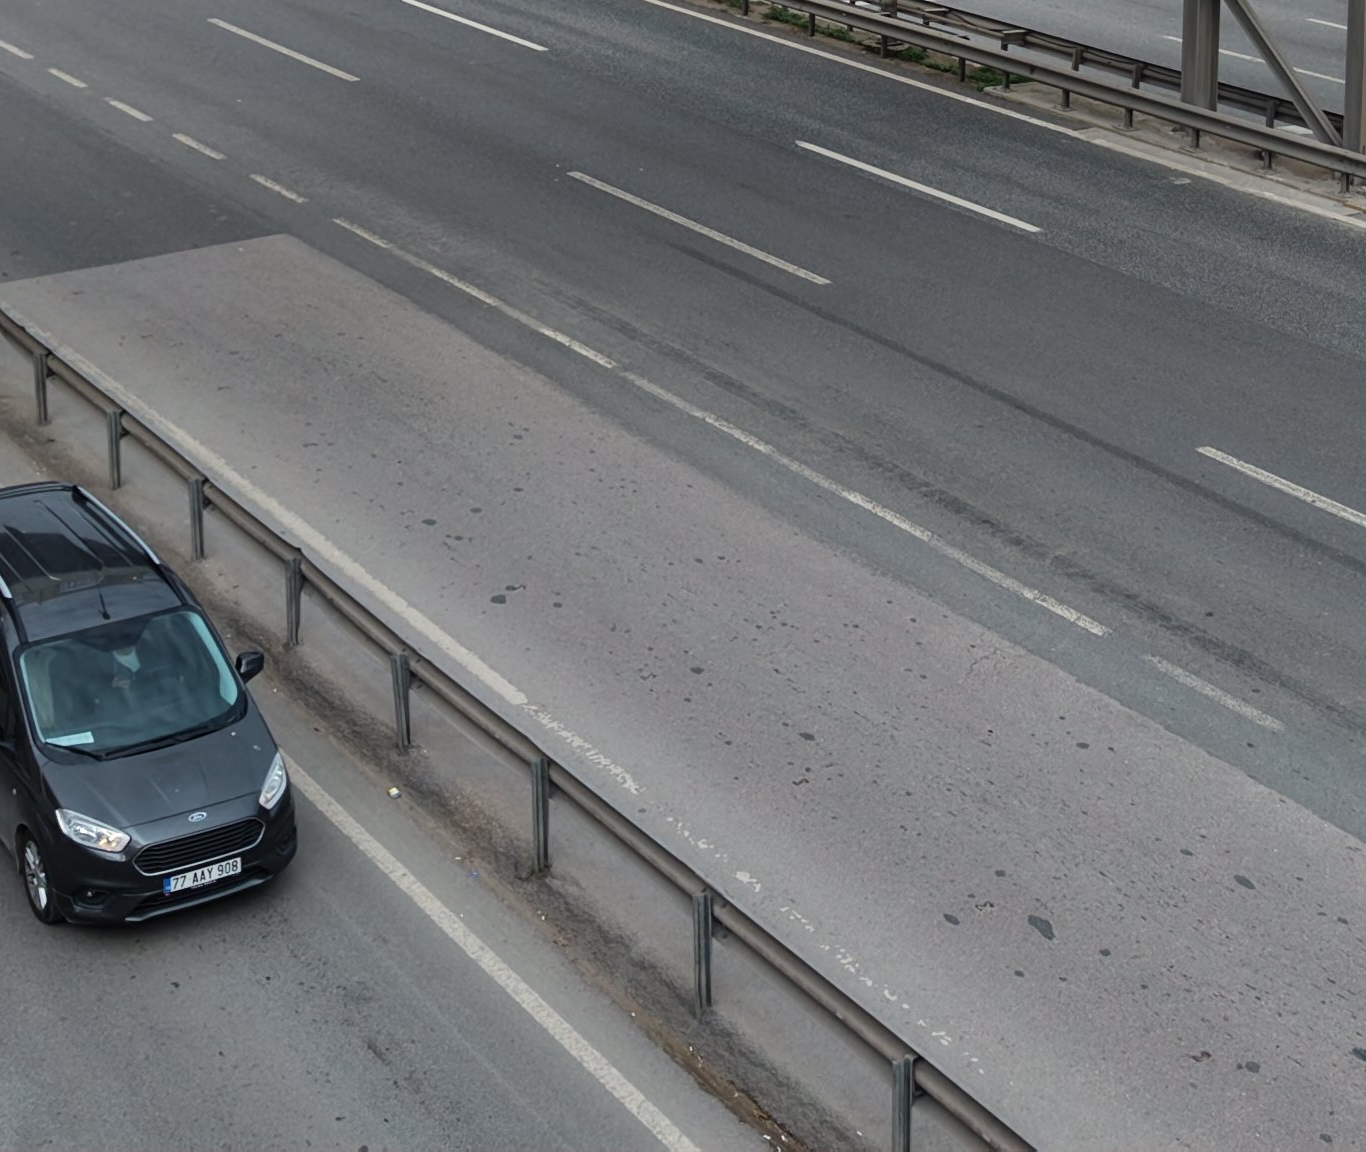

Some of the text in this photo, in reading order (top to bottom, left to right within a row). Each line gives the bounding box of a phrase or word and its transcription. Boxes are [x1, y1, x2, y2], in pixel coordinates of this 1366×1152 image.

[173, 875, 187, 890] 77
[192, 868, 213, 884] AAY
[217, 860, 238, 876] 908
